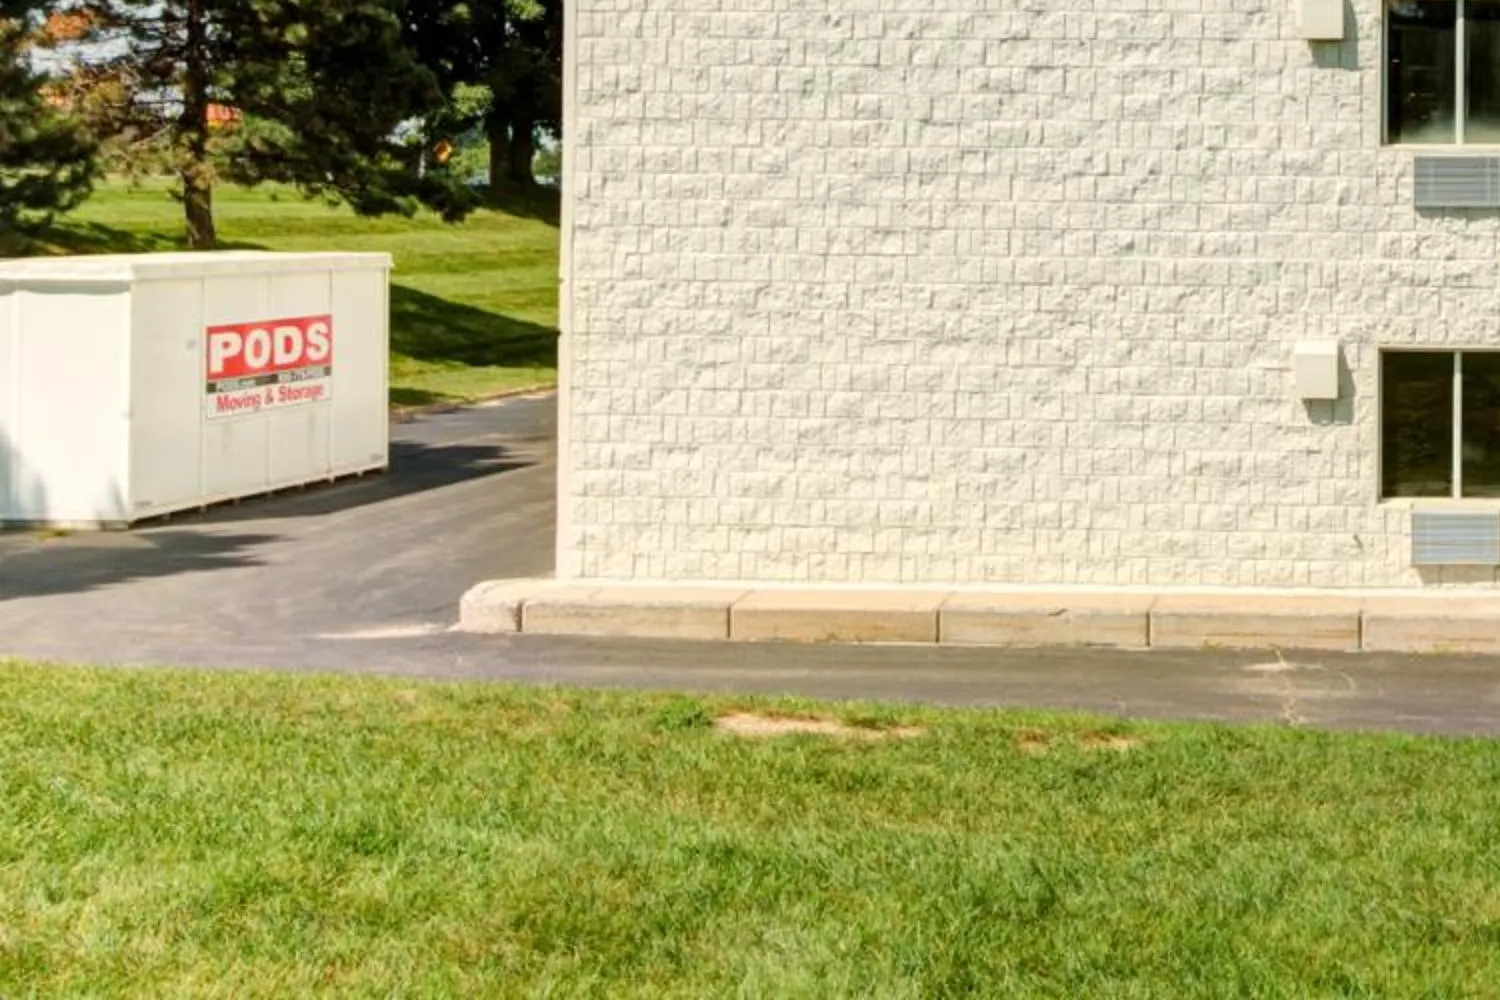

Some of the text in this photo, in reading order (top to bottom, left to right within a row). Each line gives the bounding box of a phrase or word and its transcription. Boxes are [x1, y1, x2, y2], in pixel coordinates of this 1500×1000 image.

[209, 321, 330, 374] PODS
[216, 384, 324, 413] Moving & Storage
